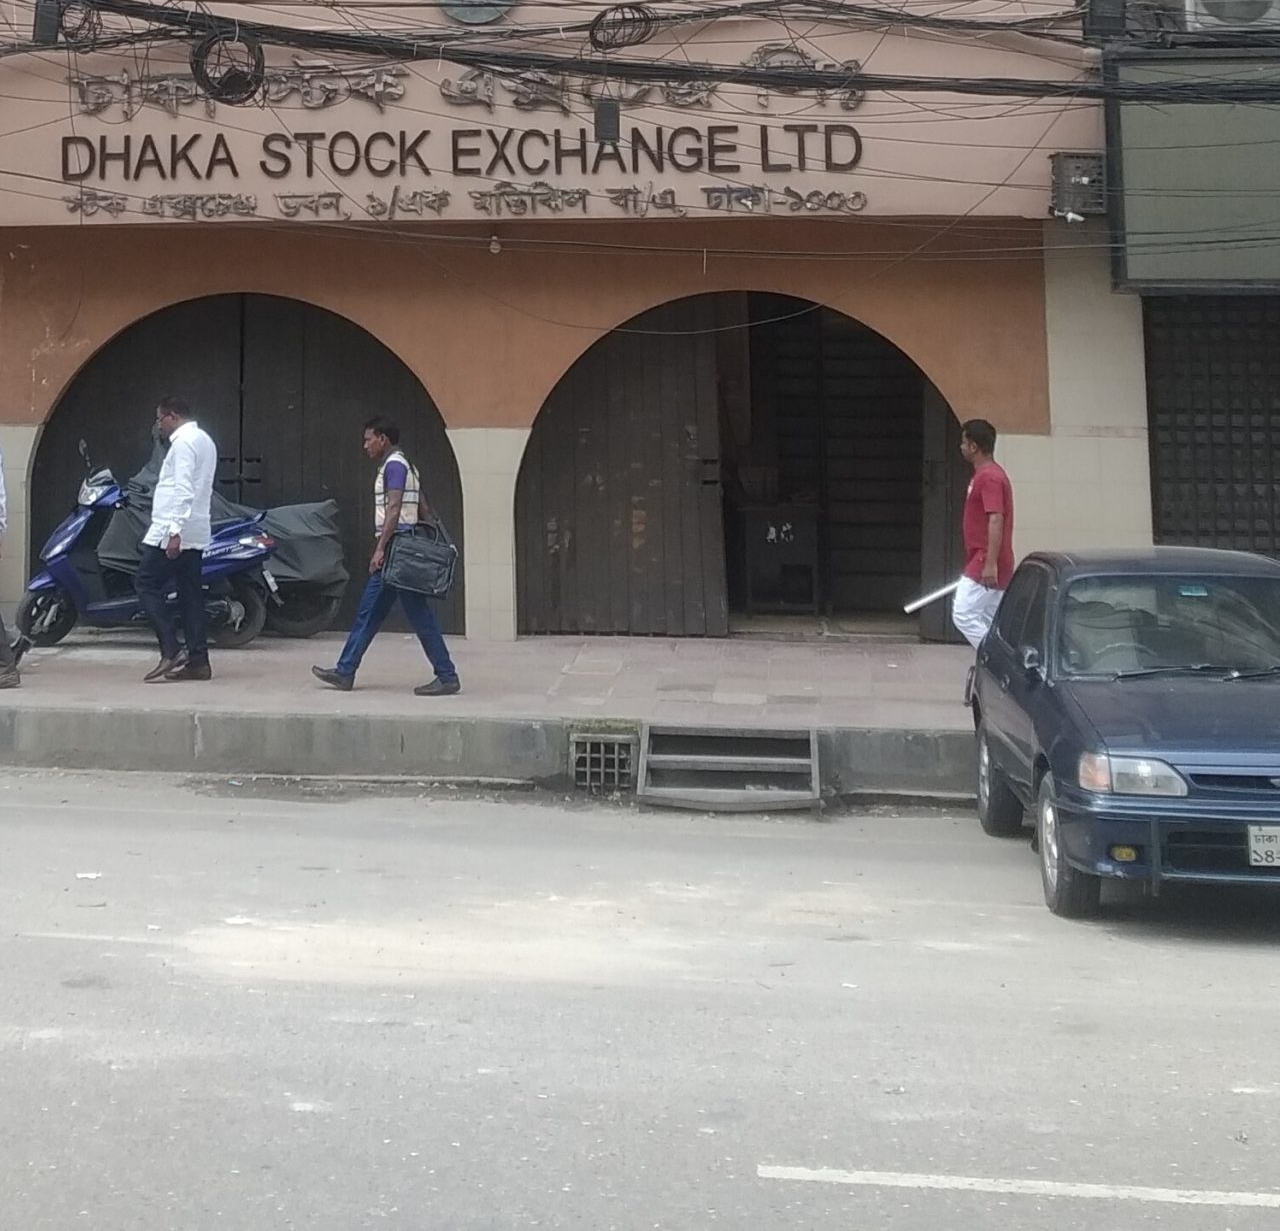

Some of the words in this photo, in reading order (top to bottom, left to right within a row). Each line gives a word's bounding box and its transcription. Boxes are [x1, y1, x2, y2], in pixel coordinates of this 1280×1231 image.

[61, 132, 239, 181] DHAKA
[259, 130, 431, 178] STOCK
[451, 125, 741, 176] EXCHANGE
[761, 124, 862, 172] LTD
